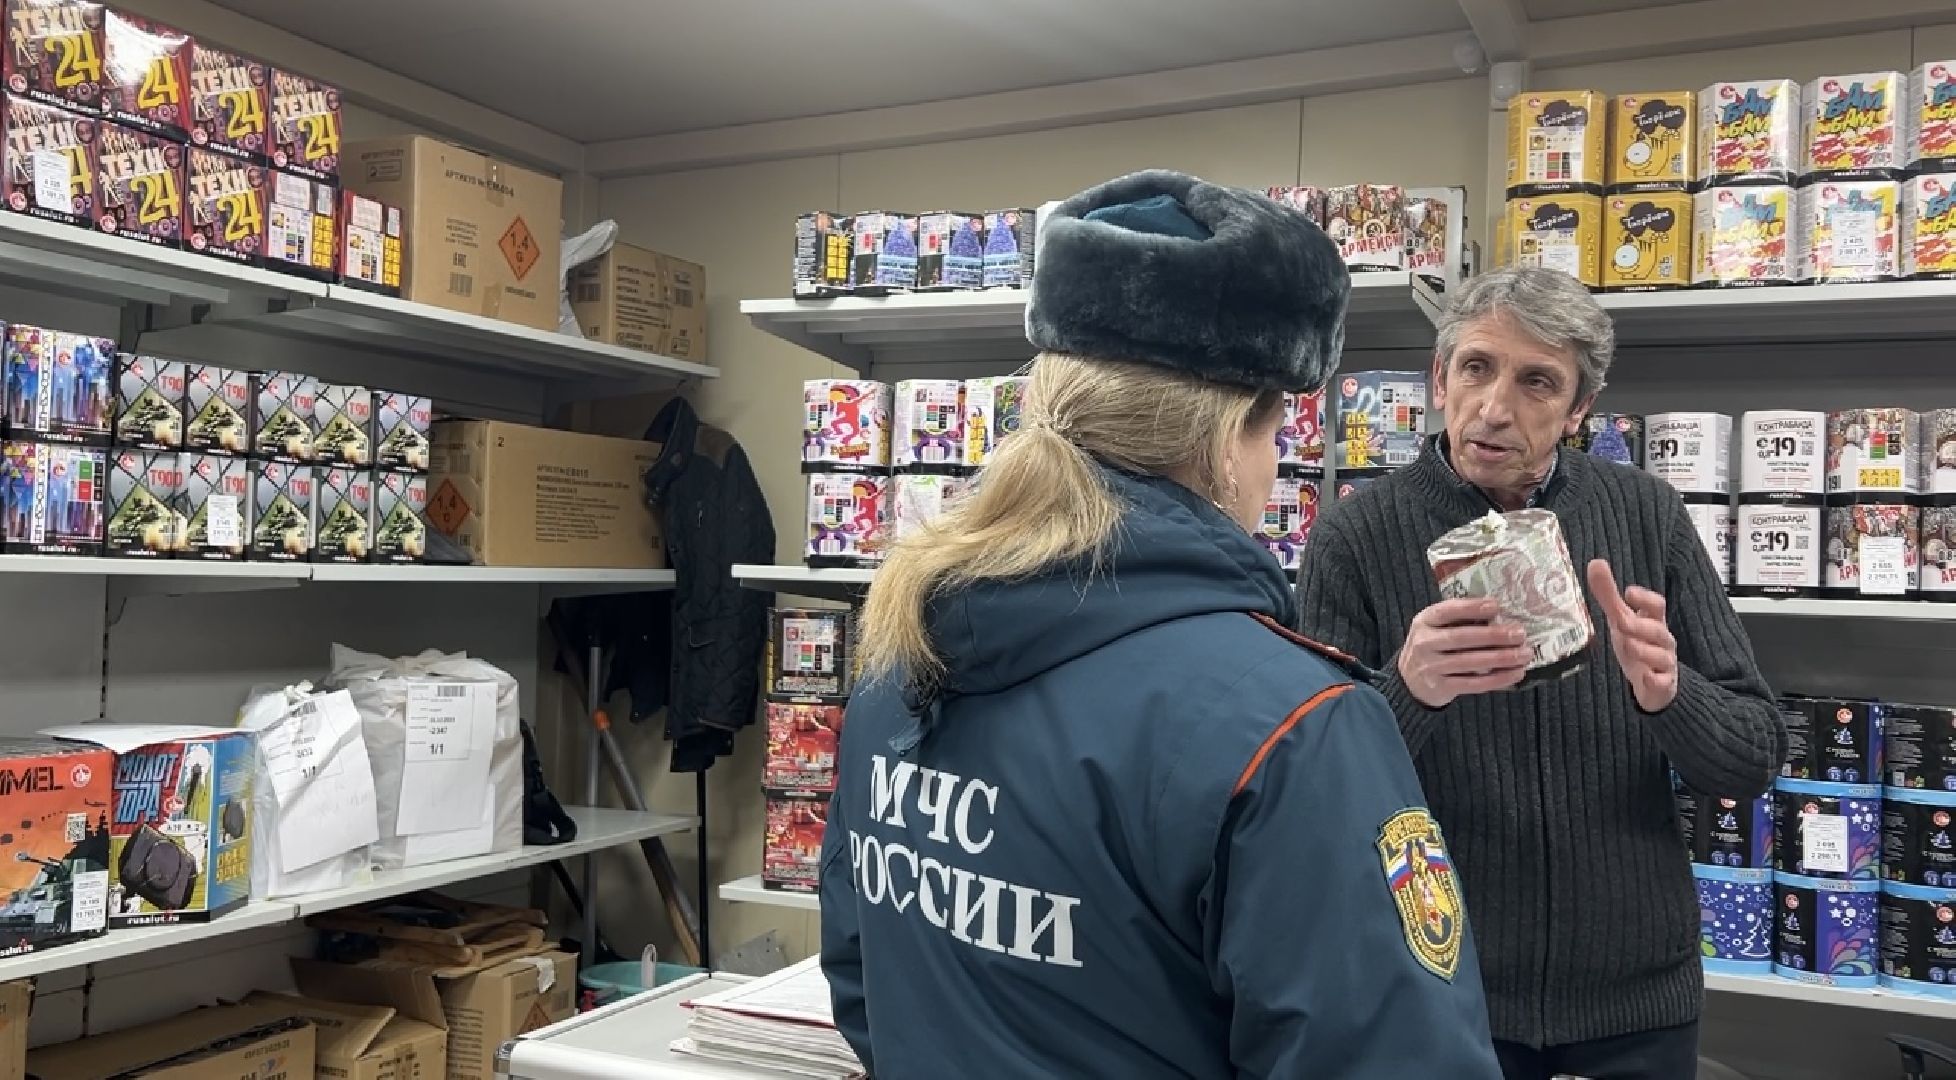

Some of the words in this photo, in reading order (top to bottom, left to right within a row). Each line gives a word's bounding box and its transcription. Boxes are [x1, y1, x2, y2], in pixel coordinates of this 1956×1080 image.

[44, 30, 100, 88] 24
[218, 88, 265, 139] 24
[297, 112, 340, 161] 24
[130, 170, 180, 224] 24
[216, 189, 263, 242] 24
[115, 753, 180, 789] МОЛОТ
[870, 754, 1000, 854] МЧС
[850, 830, 1084, 968] РОССИИ
